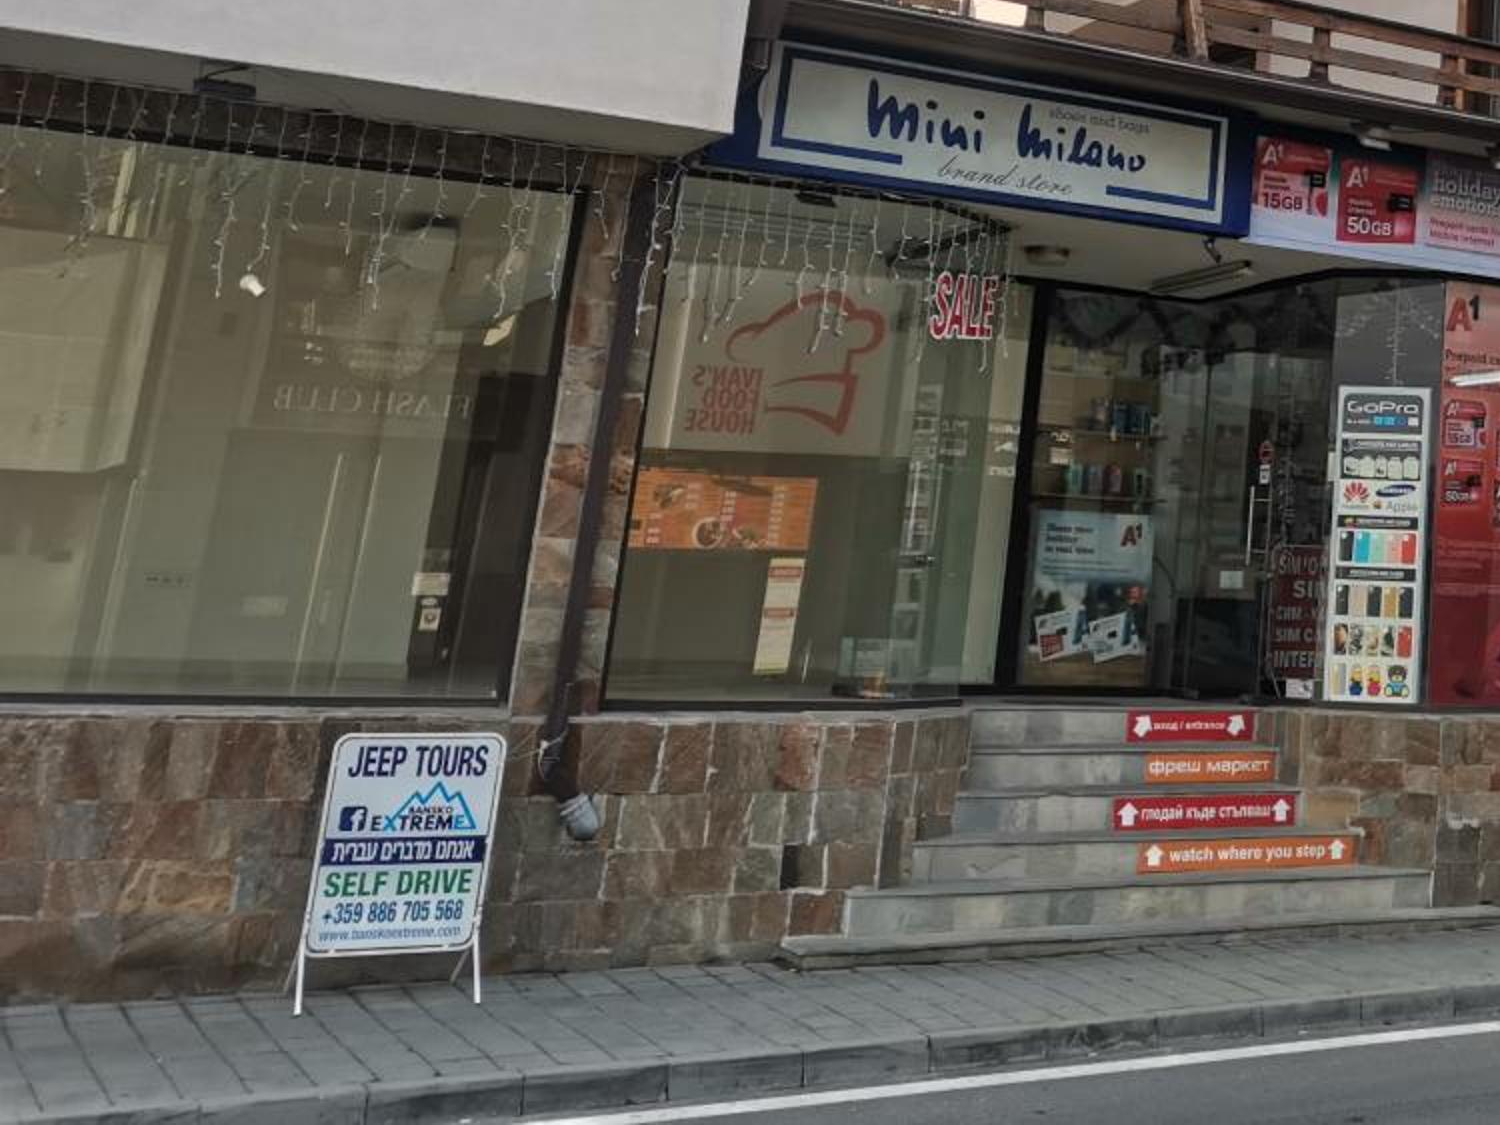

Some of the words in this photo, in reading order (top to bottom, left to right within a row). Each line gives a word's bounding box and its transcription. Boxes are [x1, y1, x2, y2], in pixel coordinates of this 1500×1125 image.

[1262, 144, 1284, 165] A1
[937, 154, 1014, 186] brand
[1016, 168, 1074, 195] store
[1346, 166, 1369, 188] A1
[1262, 192, 1303, 211] 15GB
[1346, 216, 1393, 237] 50GB
[929, 270, 999, 340] SALE
[1445, 294, 1479, 332] A1
[1346, 400, 1420, 414] GoPro
[1120, 523, 1143, 547] A1
[348, 745, 408, 778] JEEP
[415, 744, 489, 778] TOURS
[1149, 759, 1201, 776] фреш
[1206, 758, 1271, 774] маркет
[370, 814, 466, 833] EXTREME
[331, 842, 379, 863] עברית
[1169, 845, 1214, 864] watch
[1217, 845, 1263, 862] where
[1265, 845, 1293, 863] you
[1295, 843, 1326, 861] step
[324, 871, 390, 898] SELF
[395, 869, 474, 896] DRIVE
[322, 901, 363, 925] +359
[367, 901, 397, 924] 886
[402, 900, 431, 922] 705
[435, 899, 464, 921] 568
